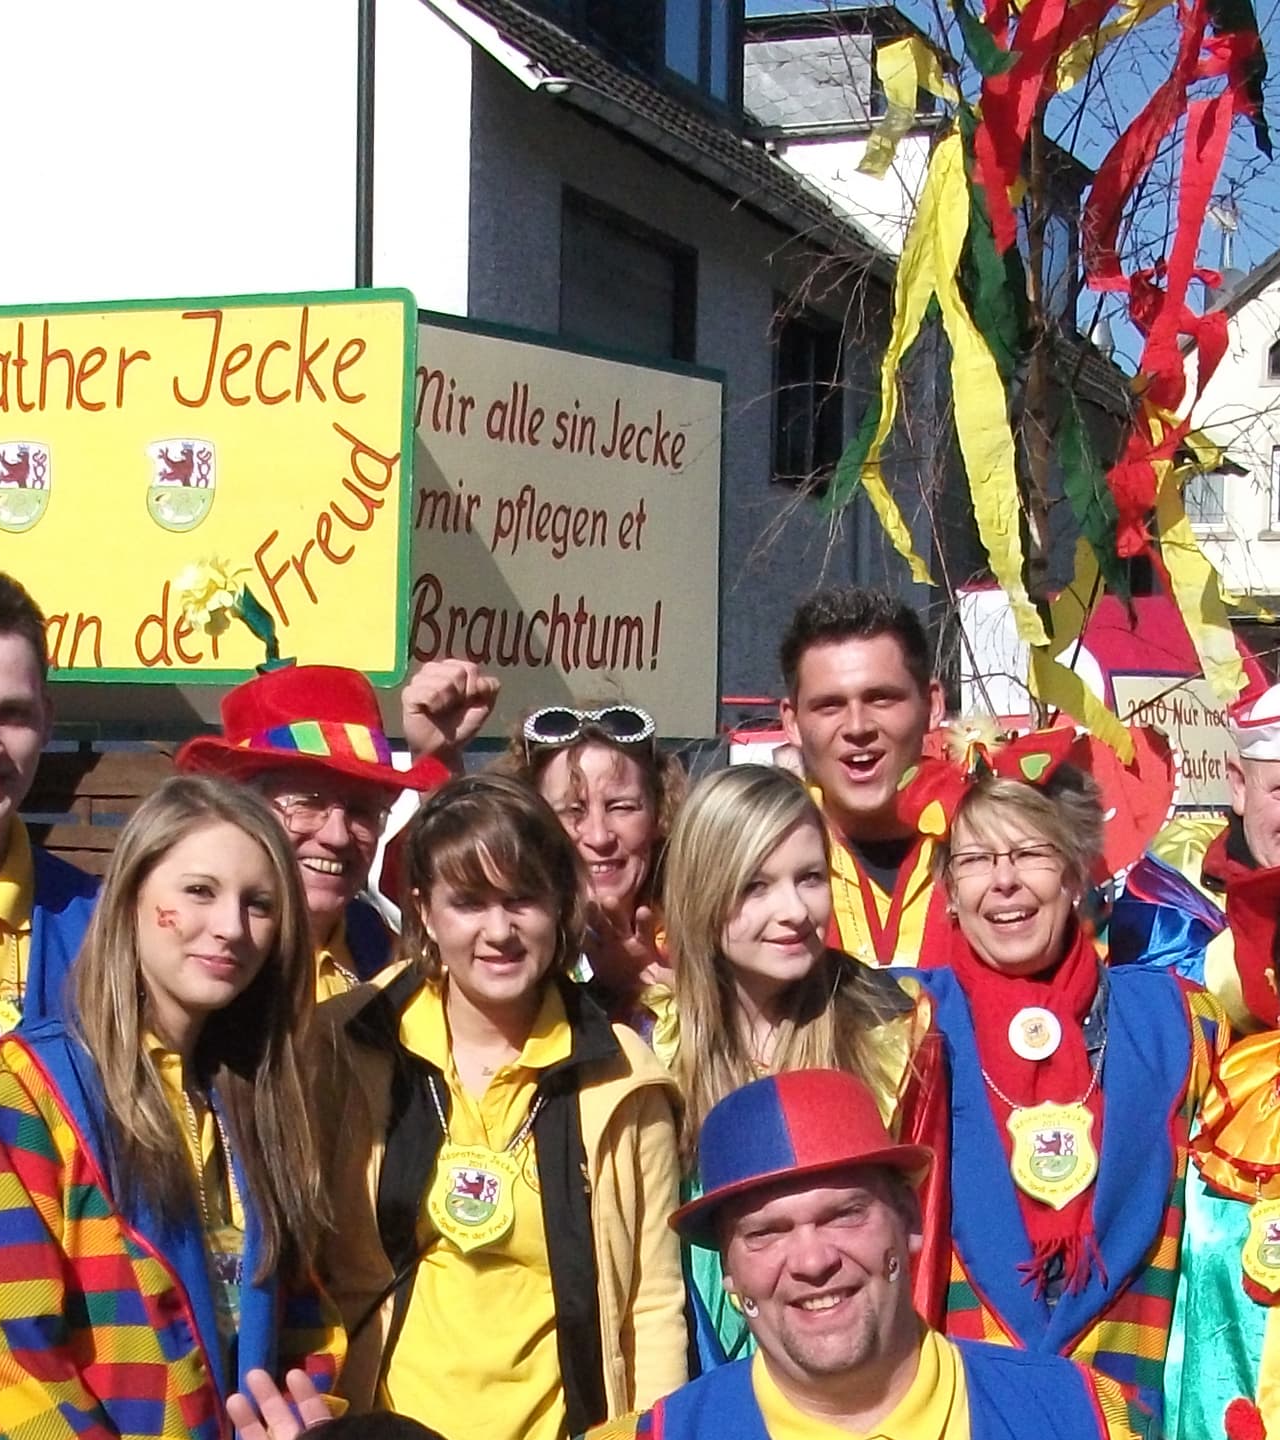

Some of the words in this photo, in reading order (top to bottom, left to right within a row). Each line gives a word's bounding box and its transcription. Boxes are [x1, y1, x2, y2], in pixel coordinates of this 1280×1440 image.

[173, 306, 368, 408] Jecke
[486, 380, 545, 447] alle
[552, 400, 596, 456] sin
[600, 398, 687, 470] Jecke
[253, 422, 401, 627] Freud
[415, 478, 482, 534] mir
[491, 483, 609, 560] pflegen
[618, 497, 647, 552] et
[409, 573, 662, 674] Brauchtum!
[1173, 698, 1198, 727] Nur
